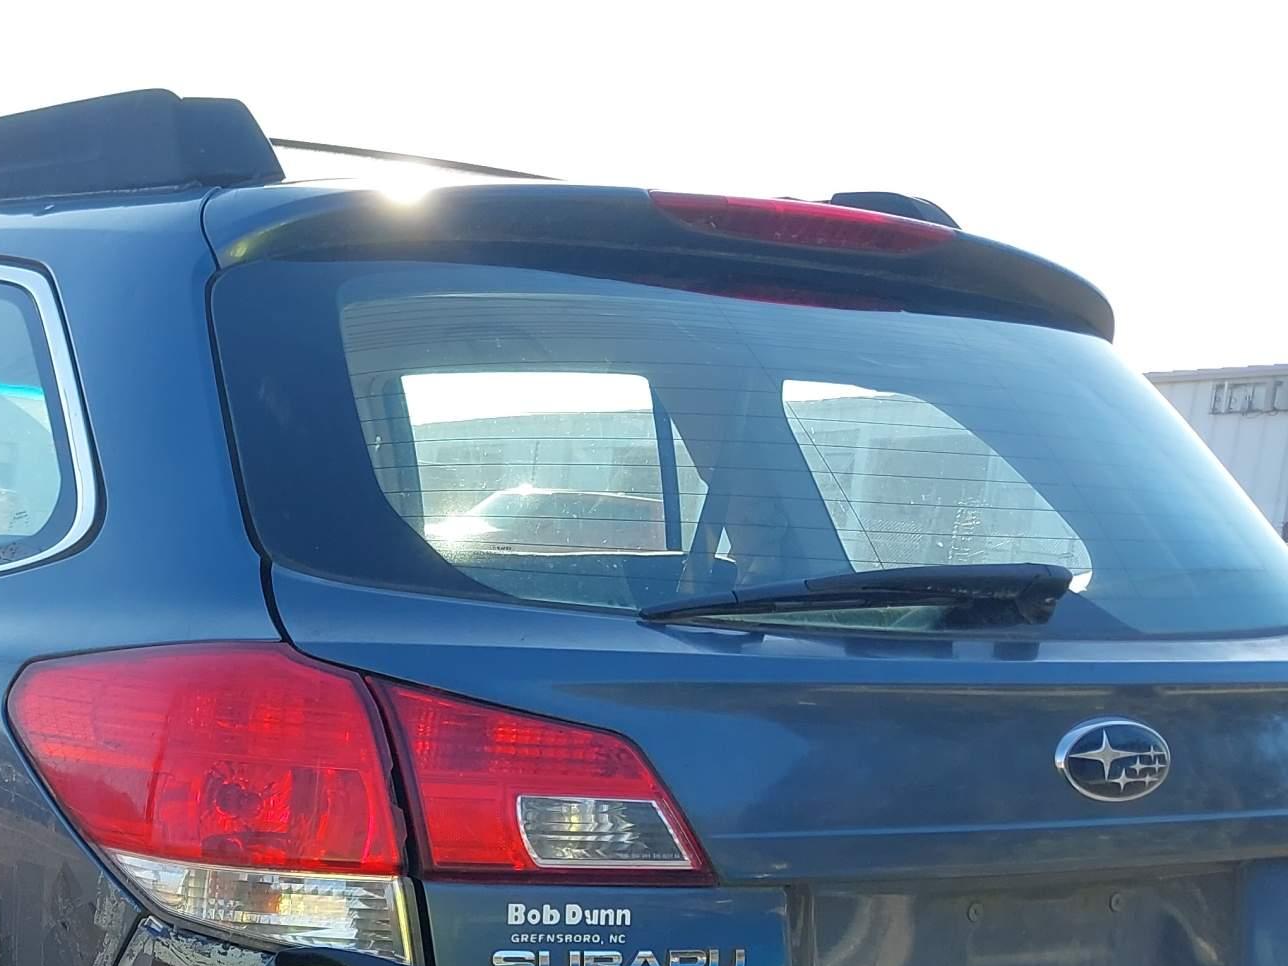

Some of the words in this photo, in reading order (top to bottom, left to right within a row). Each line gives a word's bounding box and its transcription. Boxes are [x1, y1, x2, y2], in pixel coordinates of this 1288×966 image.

[507, 903, 560, 925] Bob
[566, 904, 631, 926] Dunn
[609, 934, 626, 944] NC
